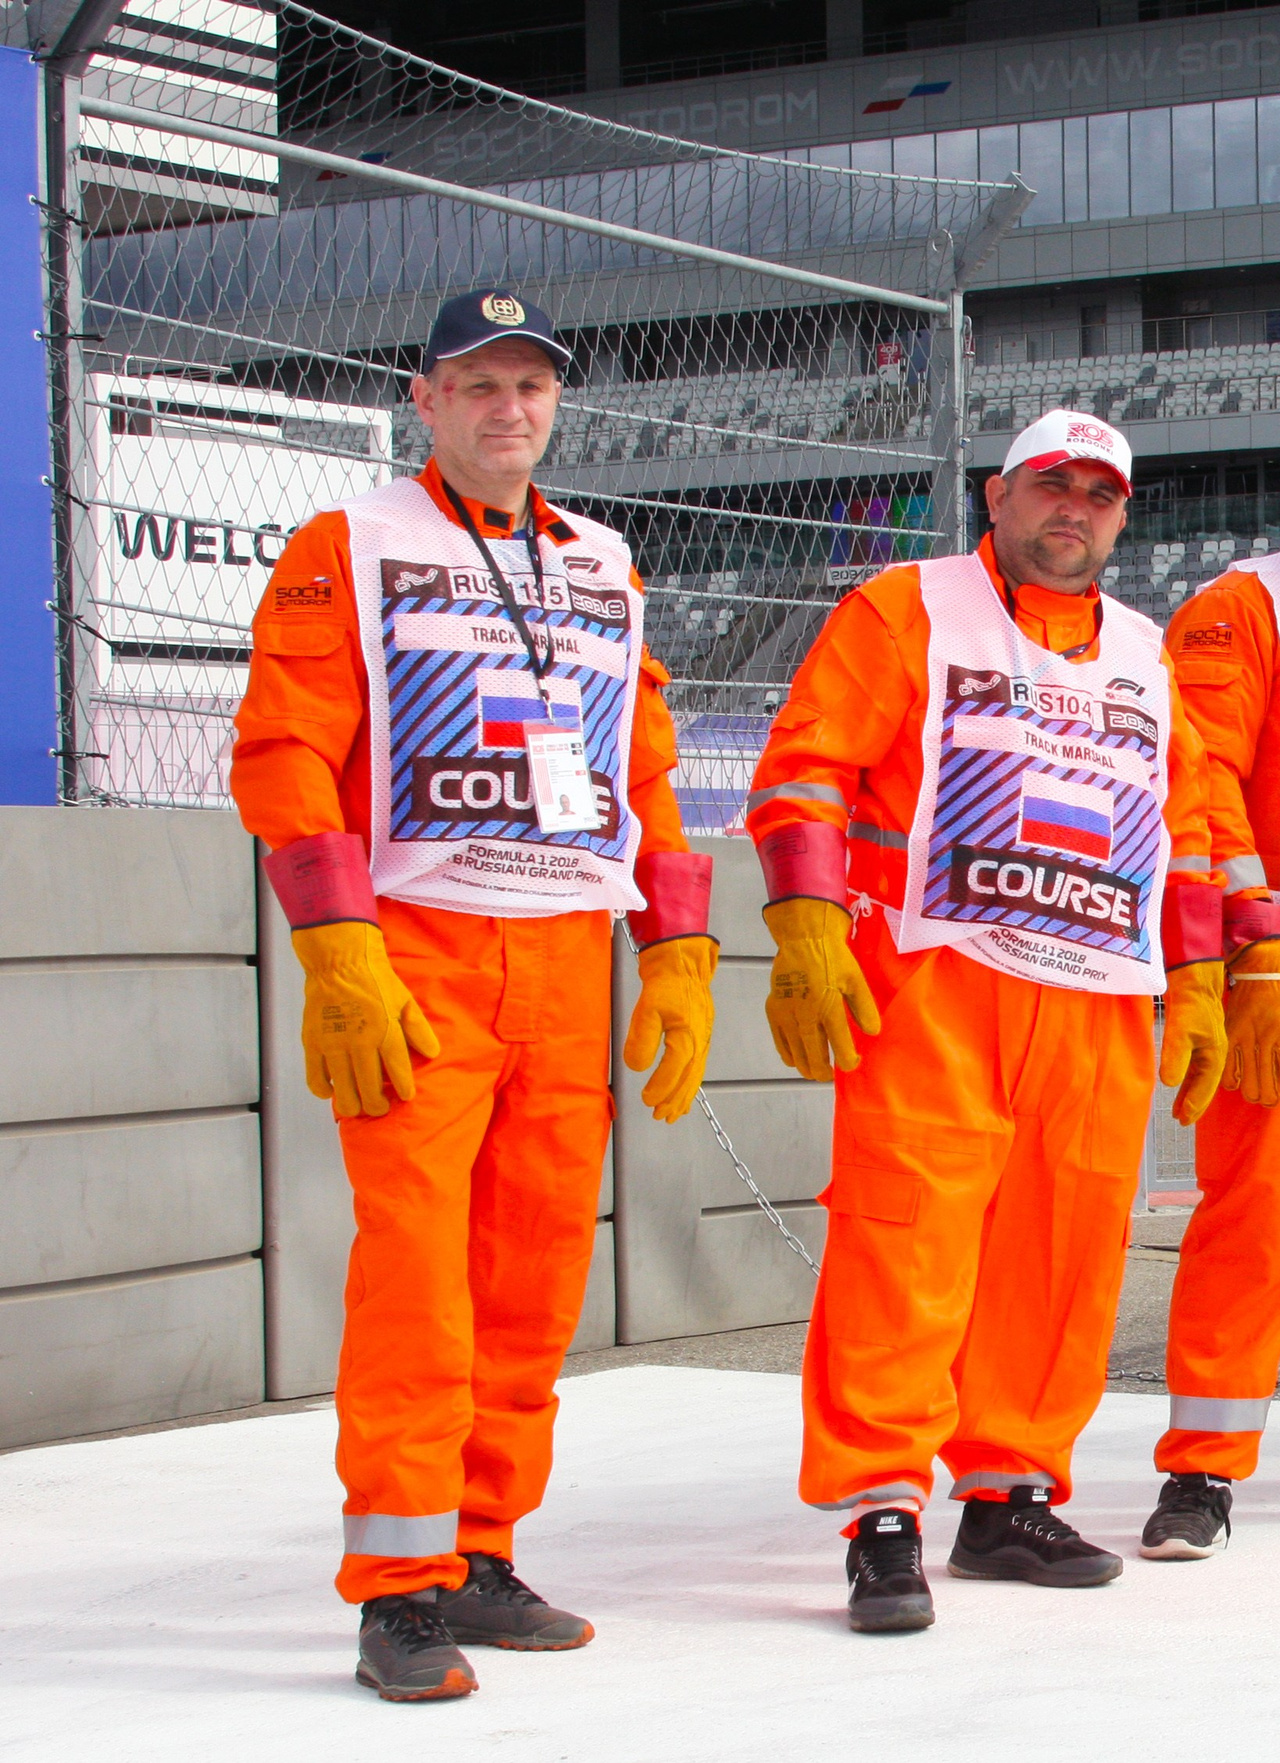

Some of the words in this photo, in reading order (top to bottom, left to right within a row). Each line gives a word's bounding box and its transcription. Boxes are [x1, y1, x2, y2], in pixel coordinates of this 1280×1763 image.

[1067, 423, 1114, 448] ROS
[275, 587, 332, 599] SOCHI
[472, 627, 517, 644] TRACK
[521, 632, 581, 654] ARHAL
[1184, 630, 1232, 641] SOCHI
[1024, 731, 1058, 757] TRACK
[1062, 744, 1116, 769] MARSHAL
[429, 770, 613, 826] COUE
[467, 844, 536, 864] FORMULA
[537, 855, 547, 866] 1
[549, 855, 579, 868] 2018
[464, 856, 526, 876] RUSSIAN
[528, 866, 574, 881] GRAND
[574, 870, 605, 885] PRIX
[967, 859, 1133, 927] COURSE
[988, 930, 1039, 965] RUSSIAN
[1039, 957, 1082, 976] GRAND
[1082, 968, 1110, 982] PRIX
[997, 927, 1047, 956] ORMULA
[1048, 945, 1056, 957] 1
[1056, 947, 1087, 964] 2018
[879, 1515, 898, 1525] NIKE
